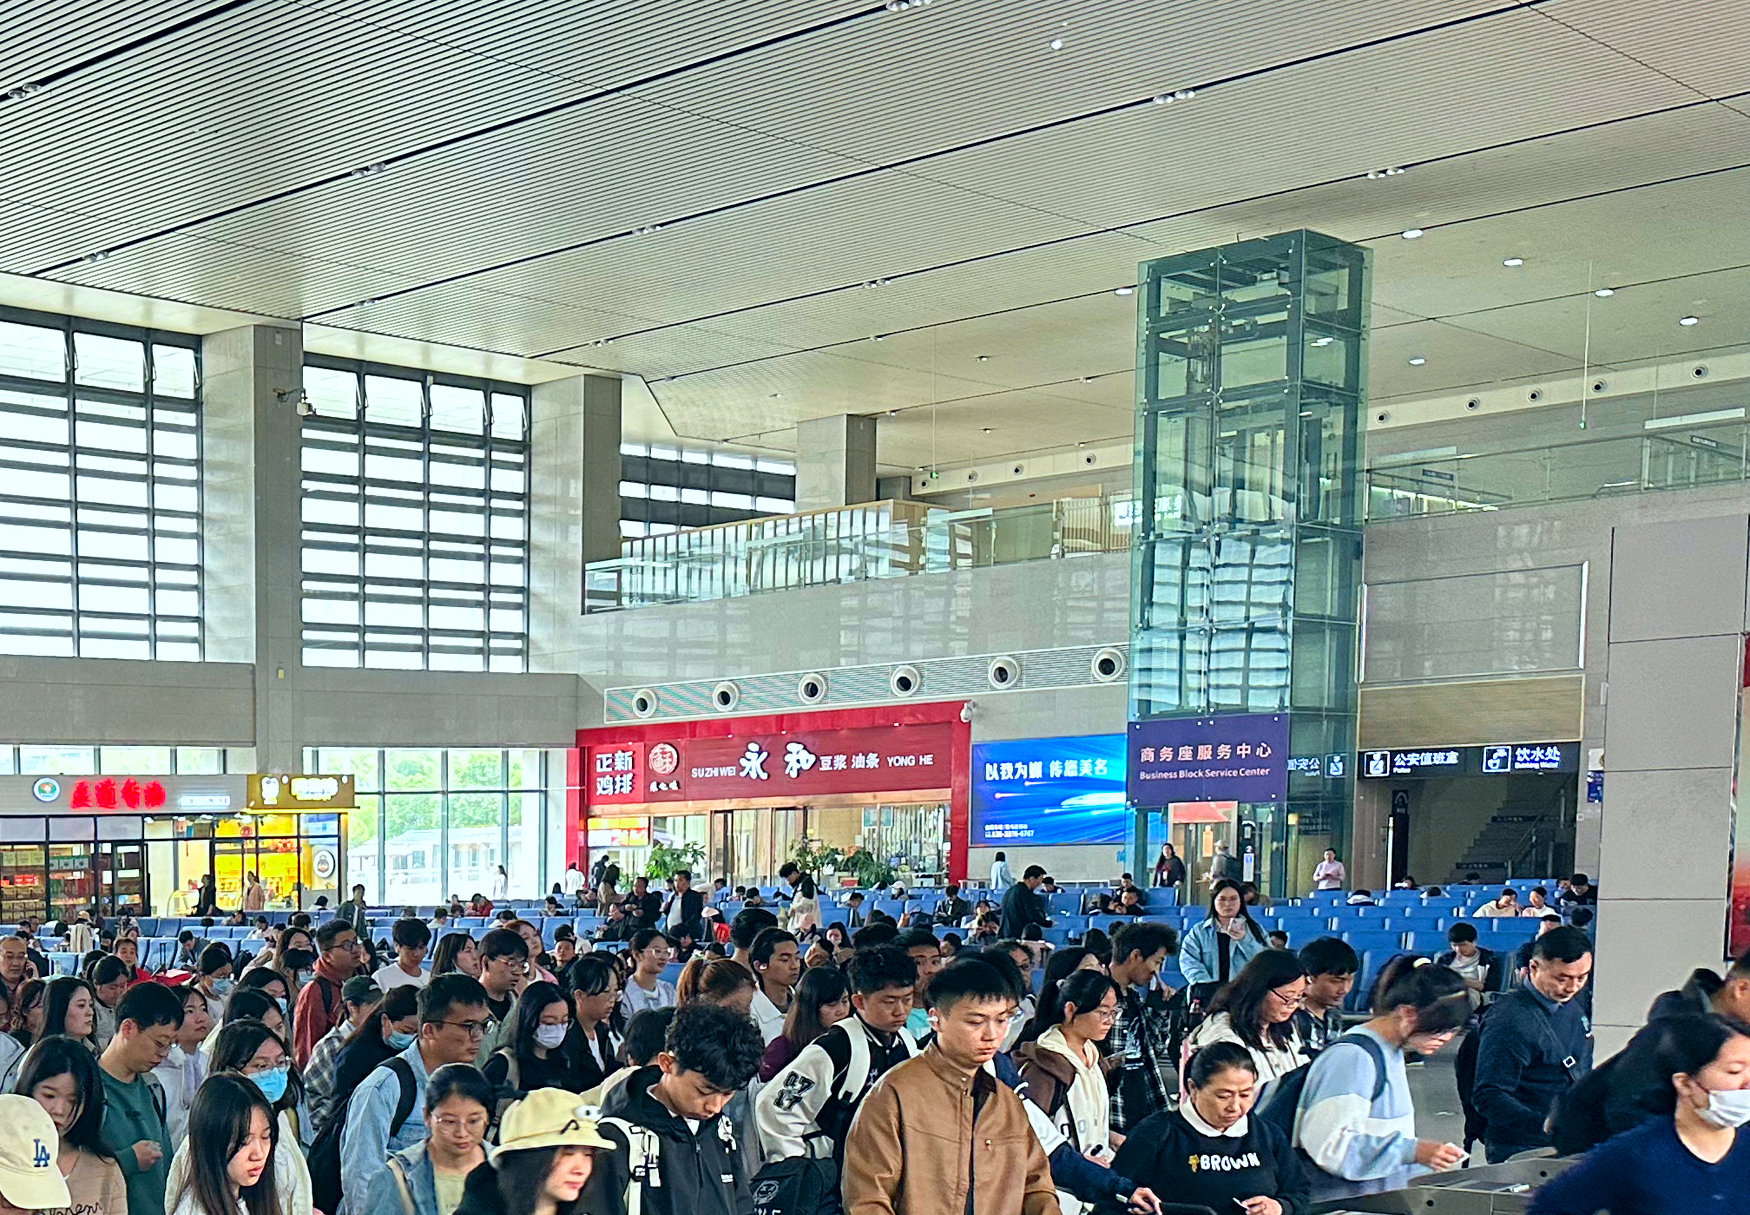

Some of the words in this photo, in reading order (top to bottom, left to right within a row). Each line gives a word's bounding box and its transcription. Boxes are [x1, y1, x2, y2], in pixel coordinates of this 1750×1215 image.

[596, 750, 633, 772] 正新
[739, 742, 816, 780] 永和
[851, 752, 879, 769] 油条
[887, 755, 915, 767] YONG
[919, 754, 933, 765] HE
[1140, 742, 1272, 763] 商务座服务中心
[1394, 751, 1458, 766] 公安值班室
[1515, 746, 1560, 761] 饮水处
[1140, 770, 1178, 779] Business
[1179, 769, 1203, 778] Block
[1205, 768, 1238, 777] Service
[1239, 767, 1271, 776] Center
[596, 773, 633, 796] 鸡排
[33, 1139, 50, 1167] LA
[1199, 1153, 1260, 1172] BROWN
